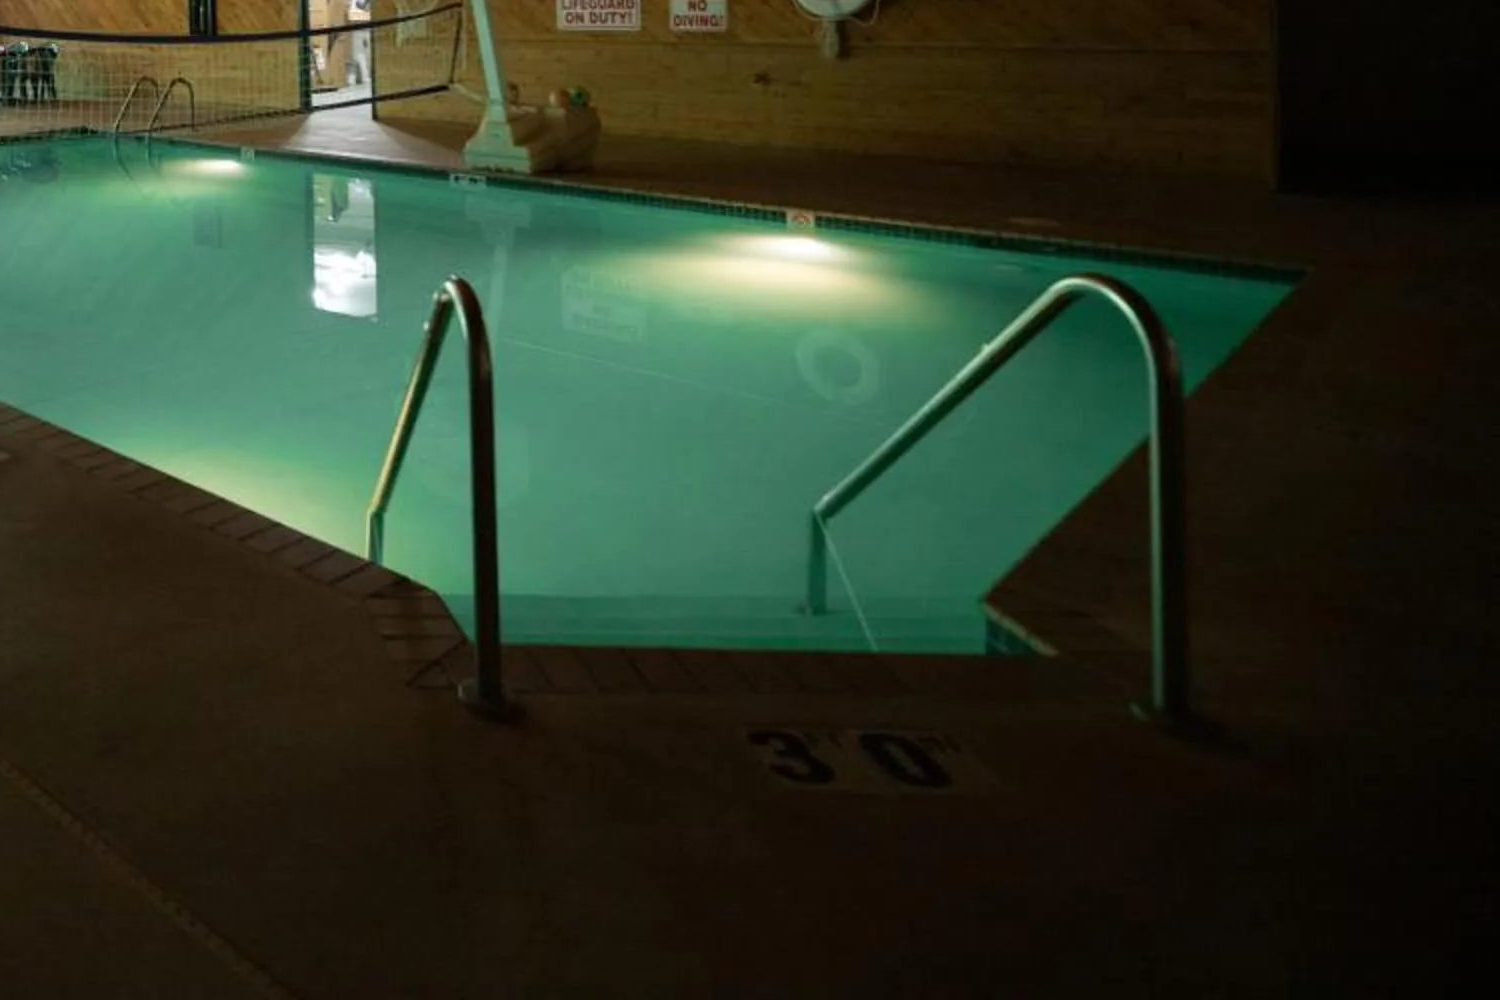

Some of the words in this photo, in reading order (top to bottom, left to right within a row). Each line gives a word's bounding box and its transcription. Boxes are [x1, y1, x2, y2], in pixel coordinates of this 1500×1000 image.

[687, 0, 708, 11] NO
[565, 11, 585, 24] ON
[589, 11, 633, 24] DUTY!
